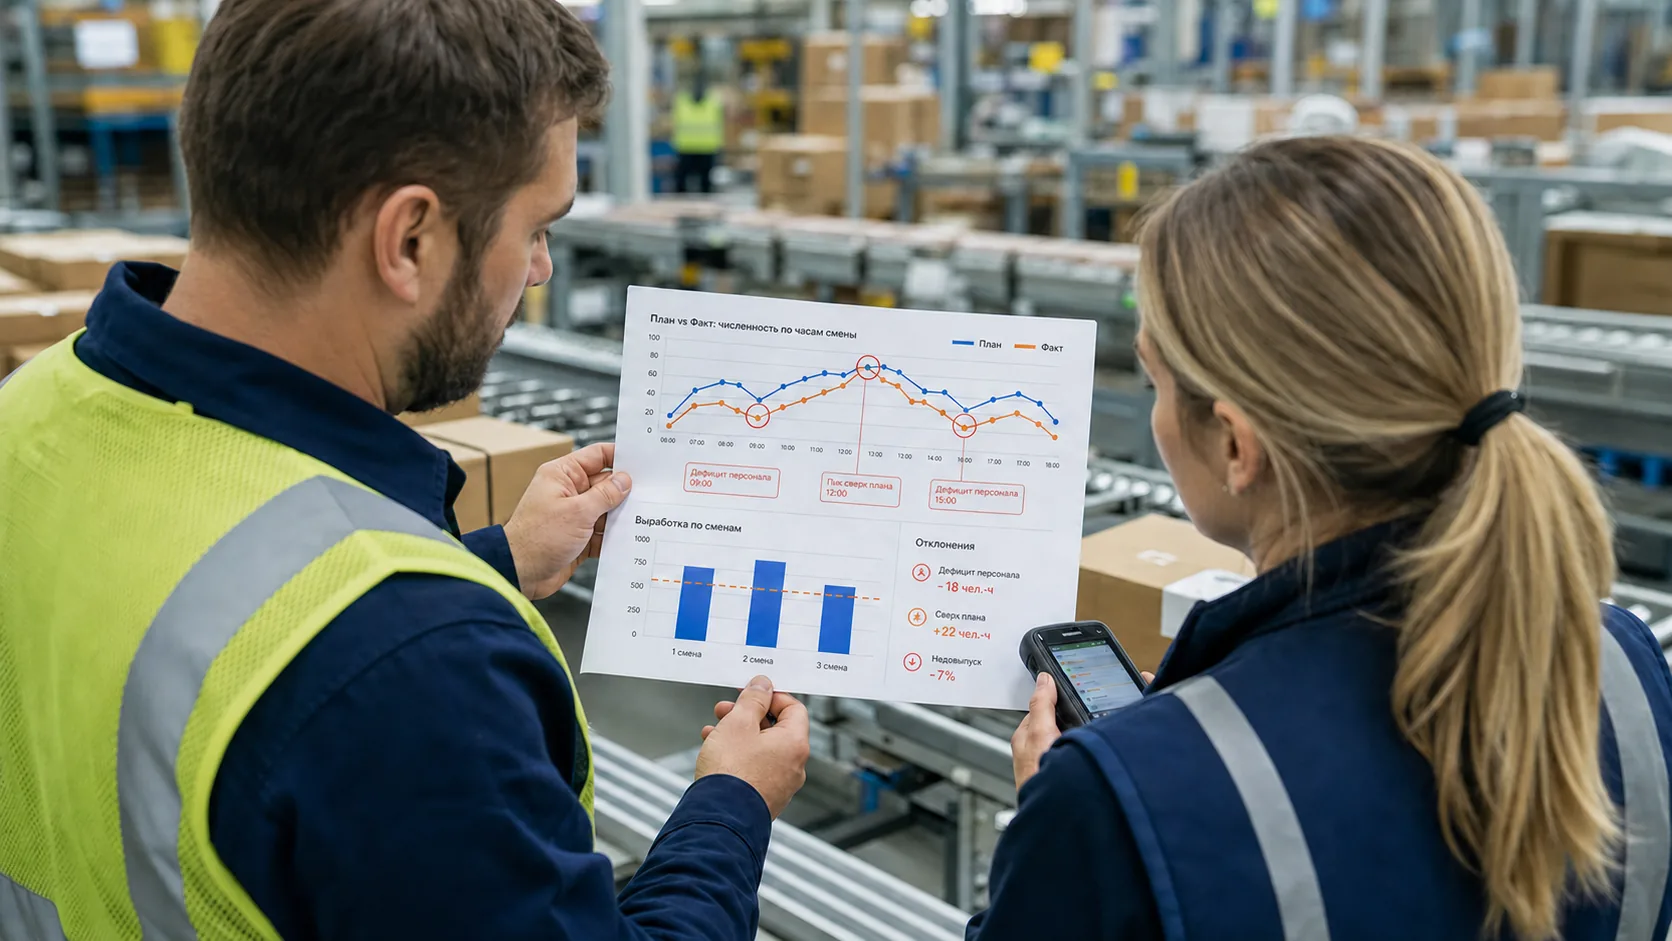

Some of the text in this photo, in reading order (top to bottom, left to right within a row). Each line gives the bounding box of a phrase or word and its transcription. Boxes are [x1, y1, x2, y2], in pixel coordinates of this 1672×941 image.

[650, 314, 857, 339] План vs Факт: численность по часам смены
[979, 340, 1002, 349] План
[1041, 343, 1063, 352] Факт
[648, 370, 657, 378] 60
[646, 389, 655, 397] 40
[826, 489, 848, 497] 12:00
[935, 485, 1018, 497] Дефицит персонала
[935, 496, 957, 504] 15:00
[635, 516, 741, 533] Выработка по сменам
[634, 535, 650, 543] 1000
[916, 538, 975, 551] Отклонения
[634, 558, 647, 566] 750
[938, 566, 1020, 579] Дефицит персонала
[630, 581, 644, 590] 500
[962, 585, 994, 595] чел.-ч
[627, 606, 640, 614] 250
[962, 613, 986, 621] плана
[934, 626, 991, 640] +22 чел.-ч
[672, 648, 702, 658] 1 смена
[743, 654, 774, 665] 2 смена
[931, 655, 982, 667] Недовыпуск
[816, 662, 848, 672] 3 смена
